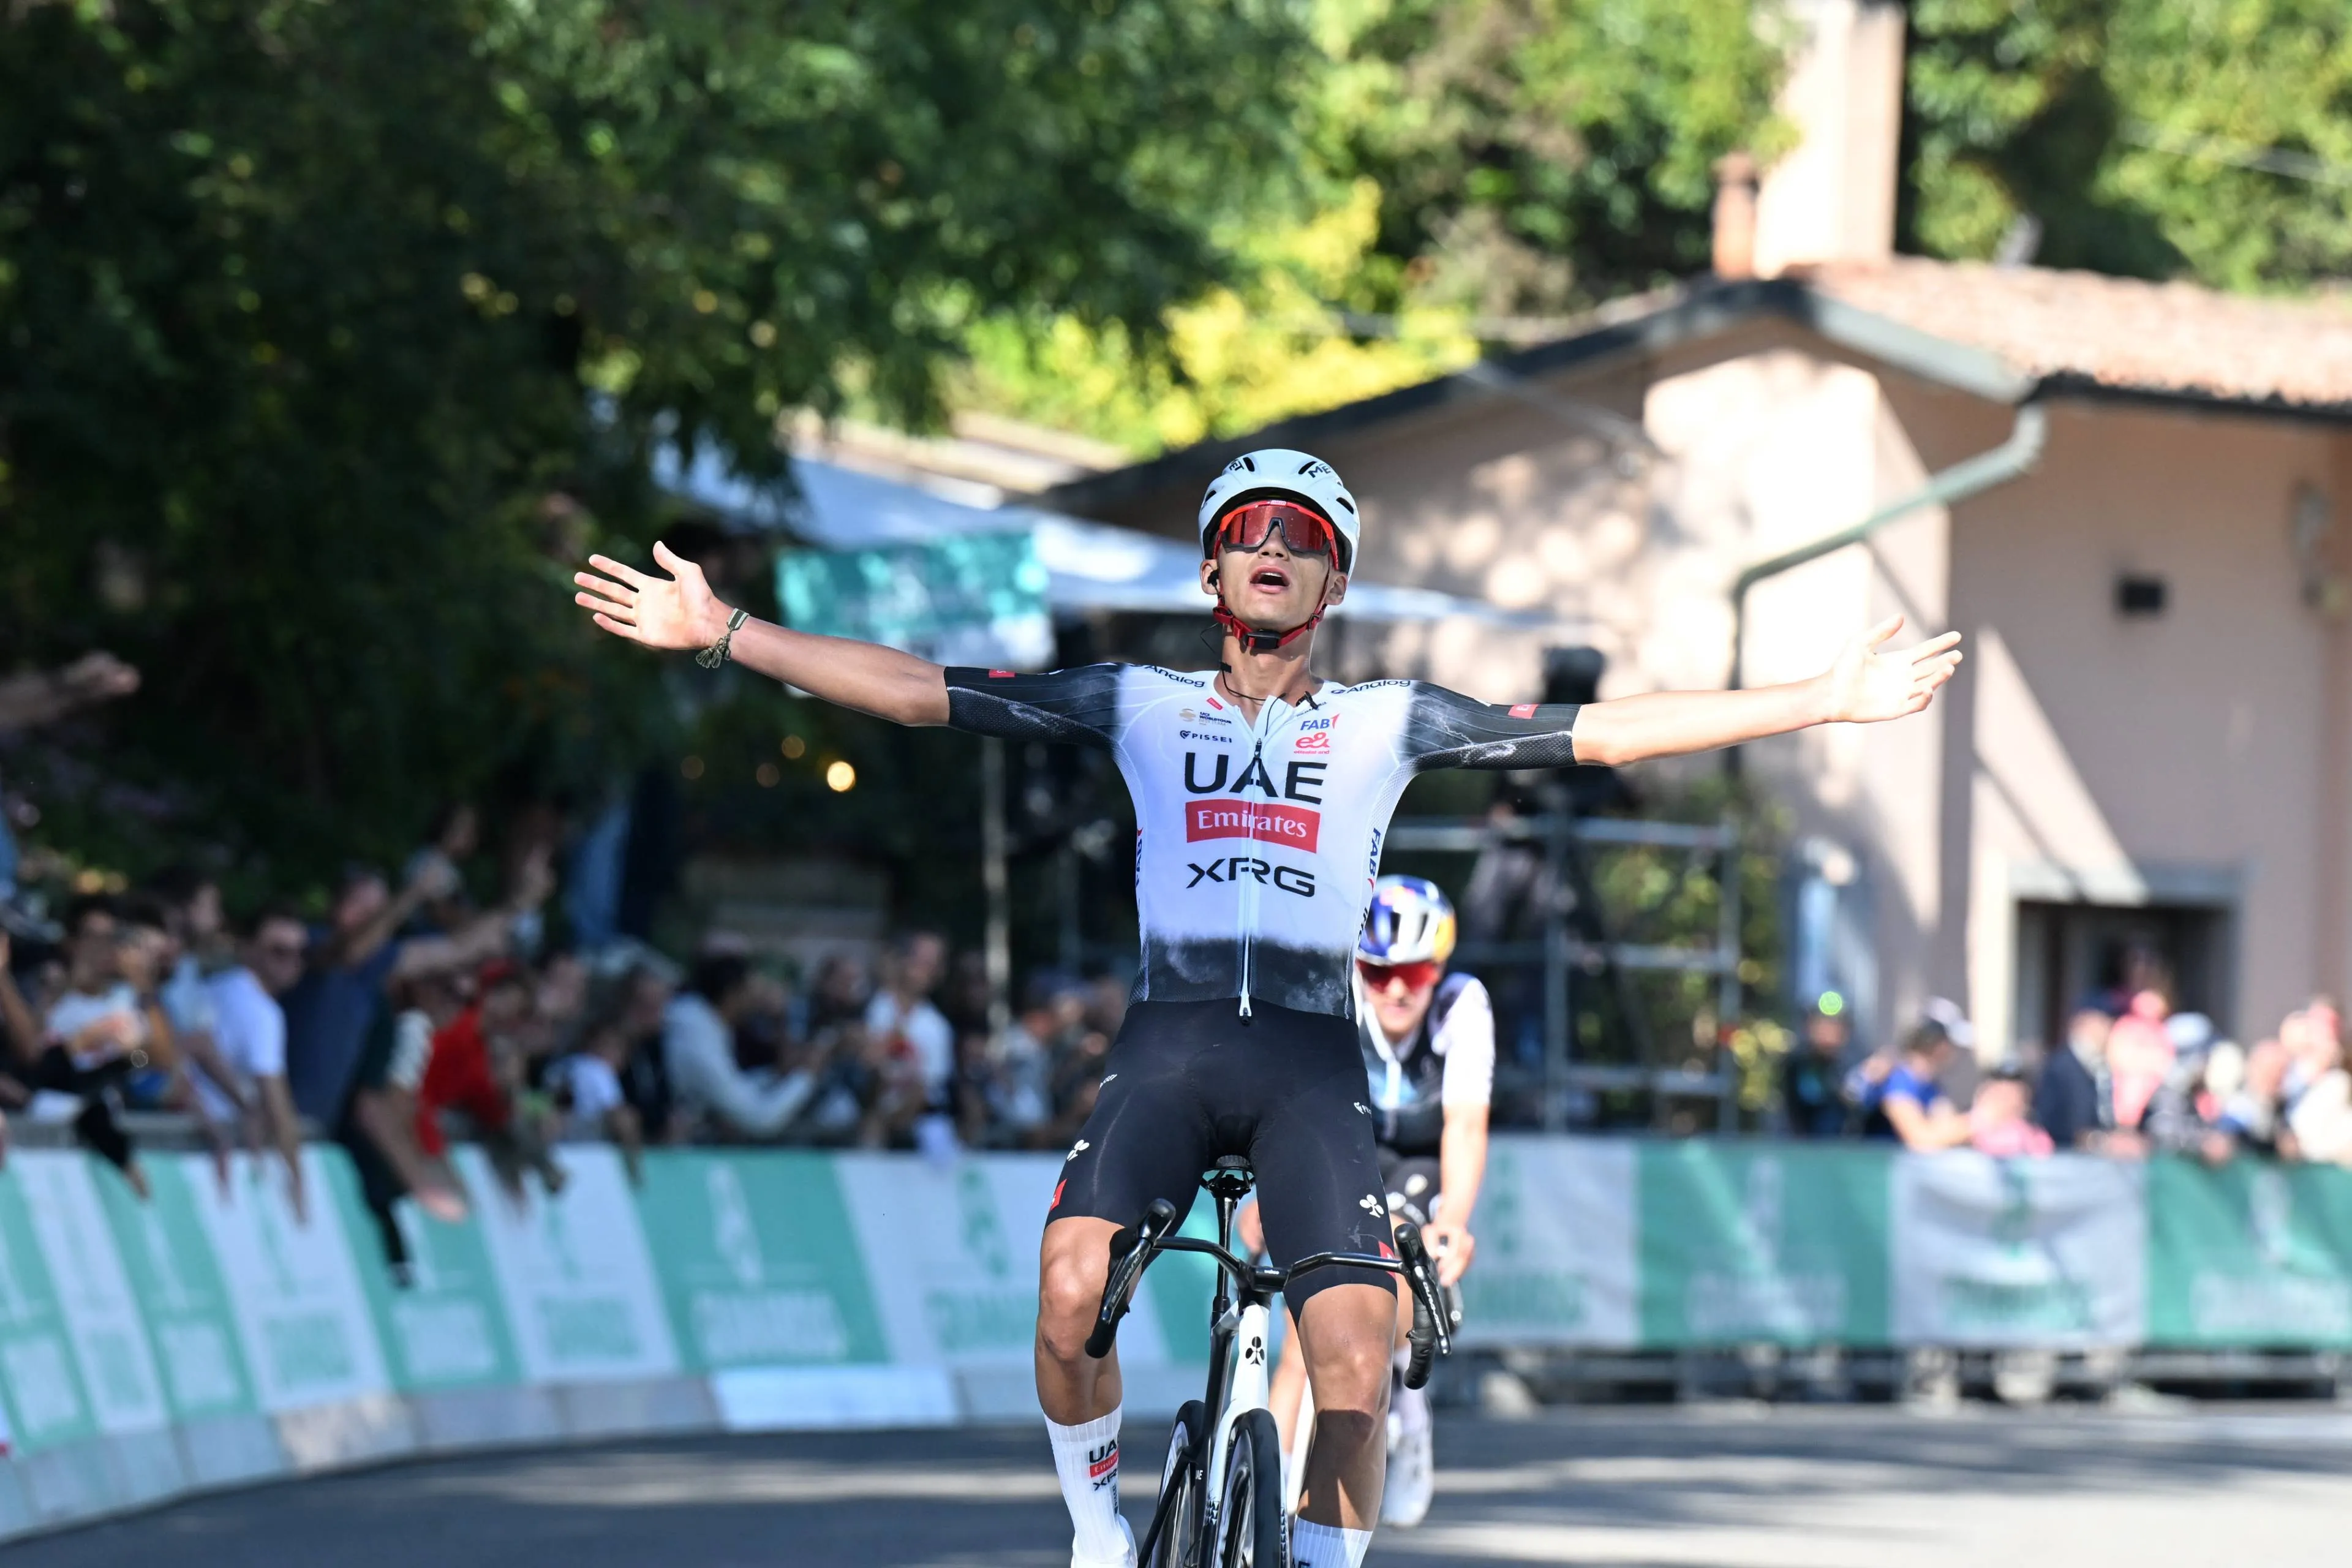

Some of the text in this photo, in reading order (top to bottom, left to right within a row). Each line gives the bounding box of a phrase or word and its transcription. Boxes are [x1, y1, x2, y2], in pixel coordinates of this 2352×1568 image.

[1229, 460, 1245, 472] ET
[1308, 462, 1332, 478] ME
[1144, 665, 1205, 688] Analog
[1347, 680, 1411, 693] Analog
[1191, 733, 1232, 743] PISSEI
[1185, 752, 1328, 805] UAE
[1197, 809, 1307, 838] Emirates
[1186, 858, 1316, 898] XRG
[1089, 1439, 1117, 1463] UA
[1093, 1469, 1117, 1491] XR
